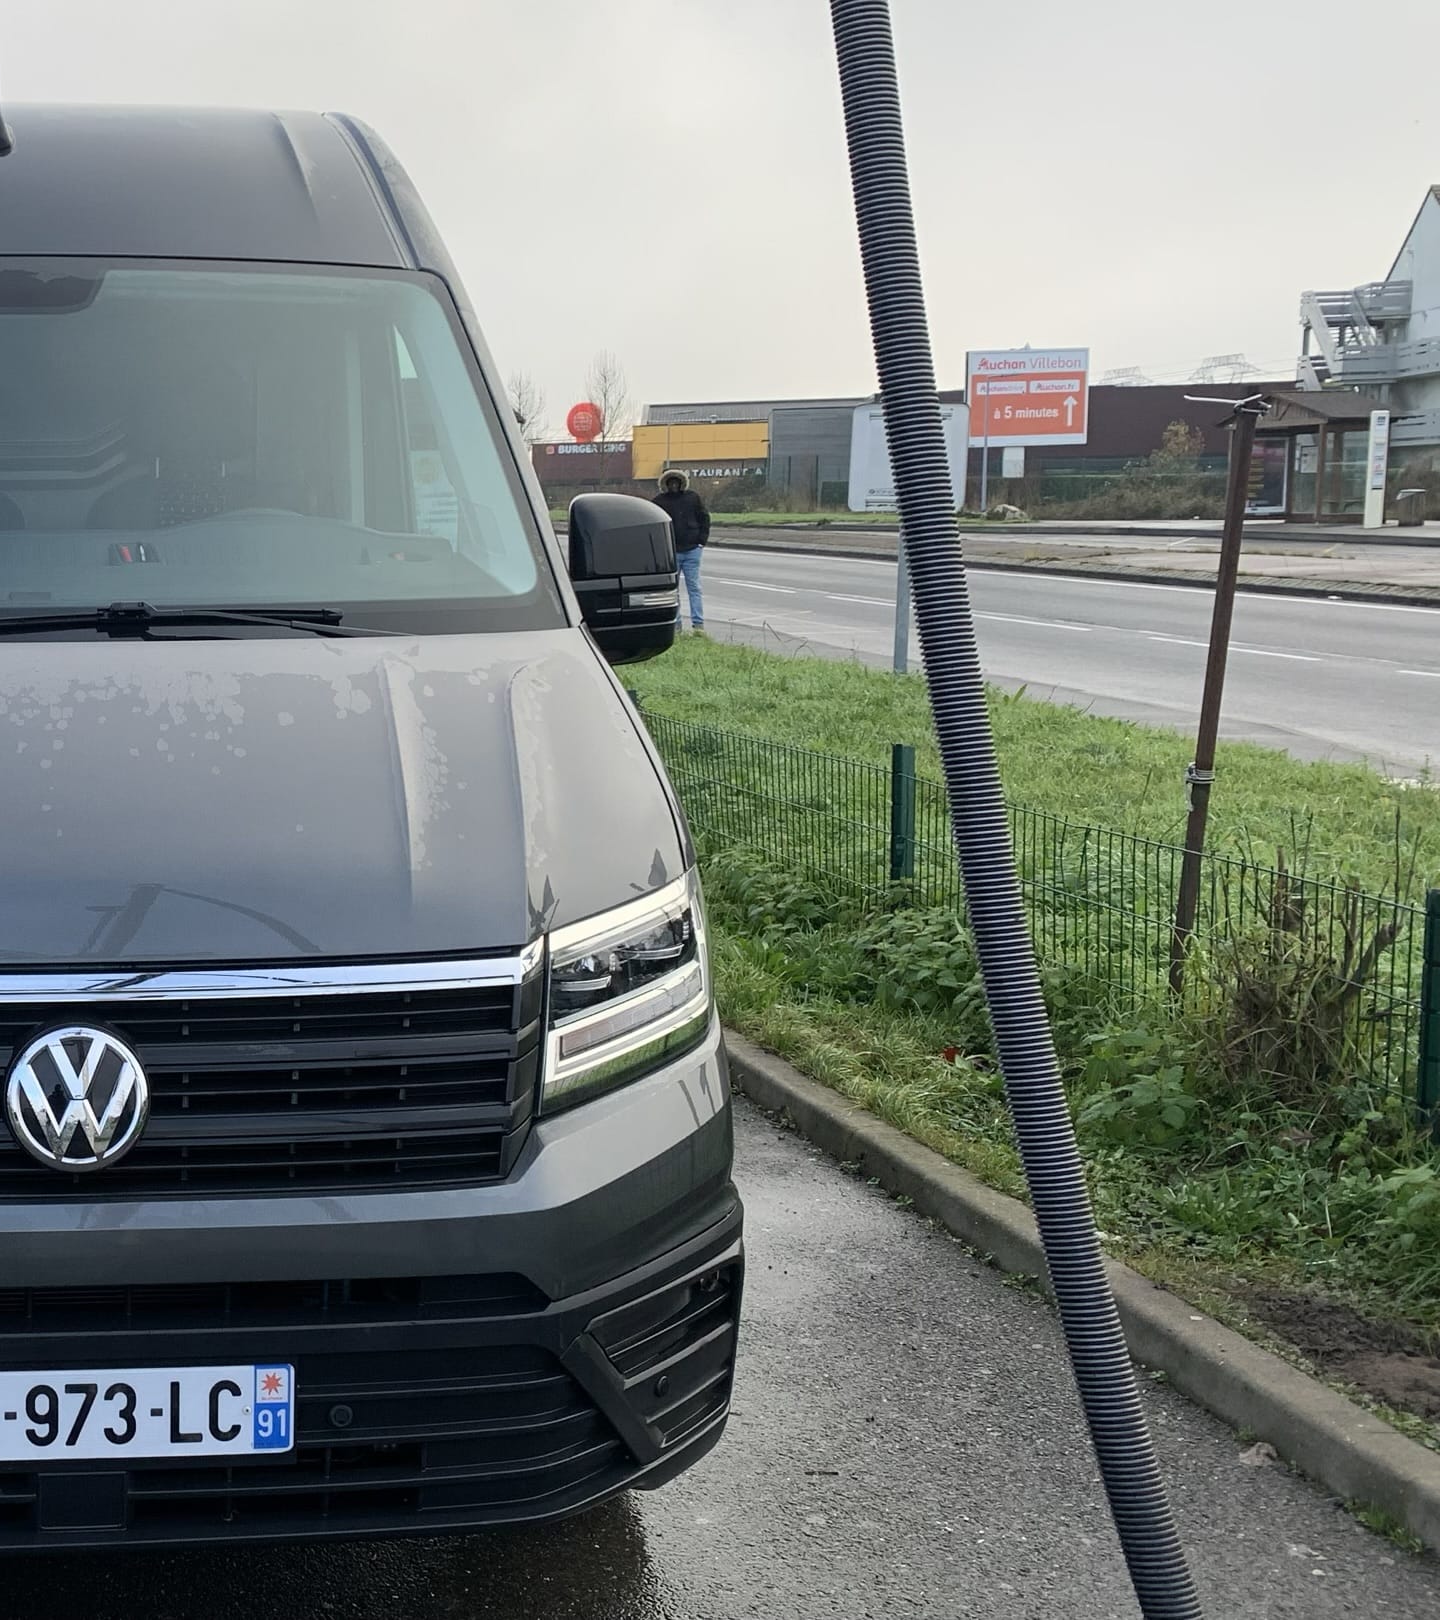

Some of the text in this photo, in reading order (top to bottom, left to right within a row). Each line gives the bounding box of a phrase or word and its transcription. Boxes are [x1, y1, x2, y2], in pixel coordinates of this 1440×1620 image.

[977, 356, 1082, 371] Auchan Villebon
[1004, 405, 1012, 419] 5
[1015, 406, 1059, 419] minutes
[558, 443, 598, 454] BURGER
[257, 1408, 286, 1438] 91
